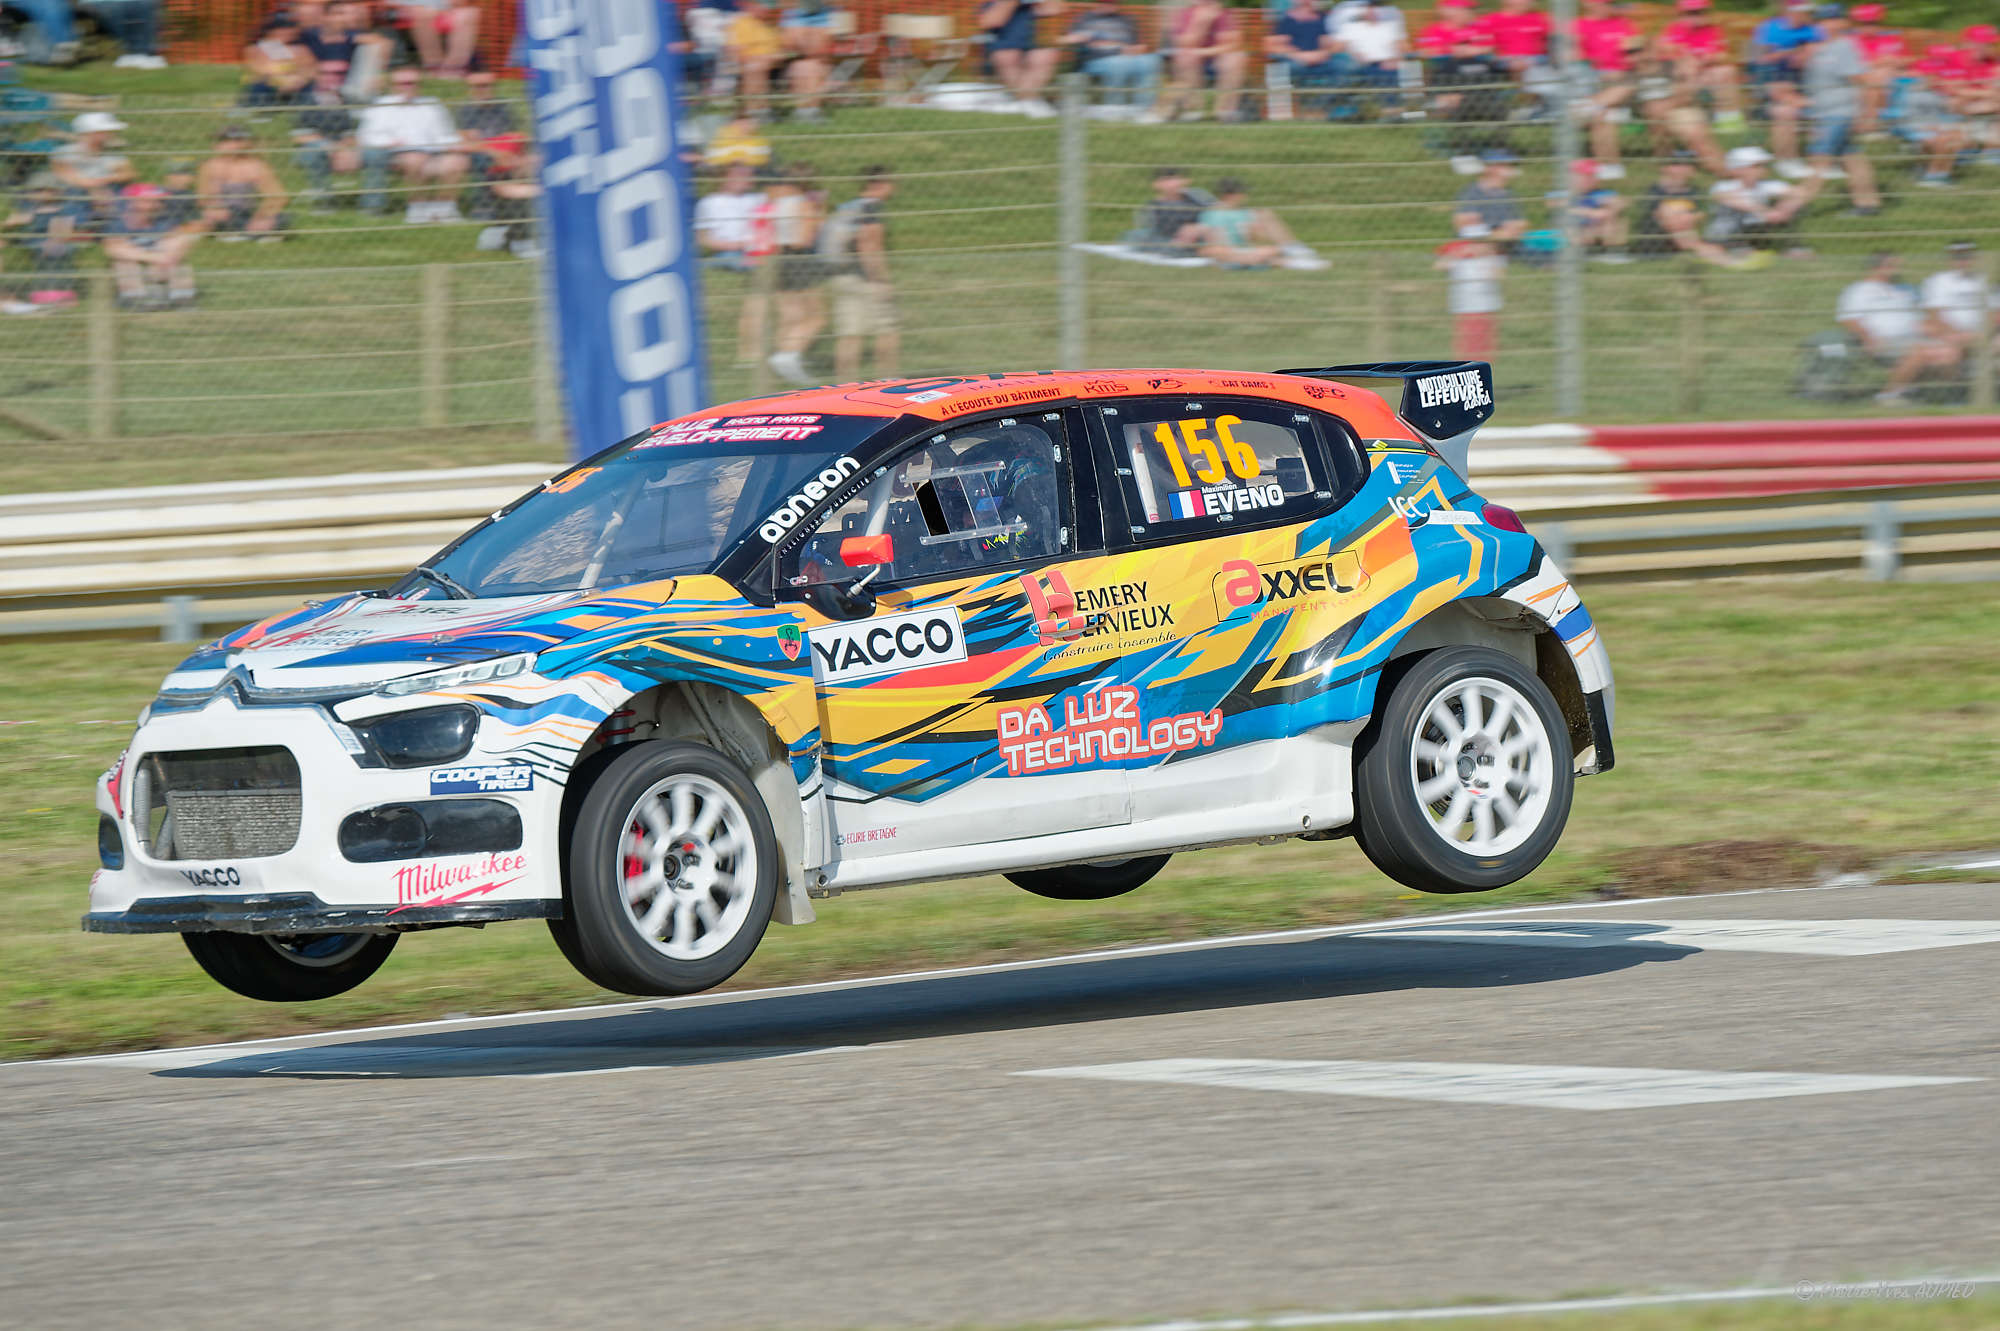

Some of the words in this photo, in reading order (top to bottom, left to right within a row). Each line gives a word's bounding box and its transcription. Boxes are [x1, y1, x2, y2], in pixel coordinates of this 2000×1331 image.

[994, 394, 1009, 404] DU
[1416, 369, 1481, 393] MOTOCULTURE
[1420, 381, 1485, 408] LEFEUVRE
[1154, 414, 1260, 488] 156
[760, 456, 860, 543] abneon
[1203, 484, 1285, 516] EVENO
[812, 618, 954, 673] YACCO
[1001, 707, 1049, 739] DA
[1068, 691, 1136, 727] LUZ
[1003, 713, 1220, 771] TECHNOLOGY
[431, 765, 531, 783] COOPER
[477, 779, 529, 791] TIRES
[391, 853, 527, 907] Milwakee
